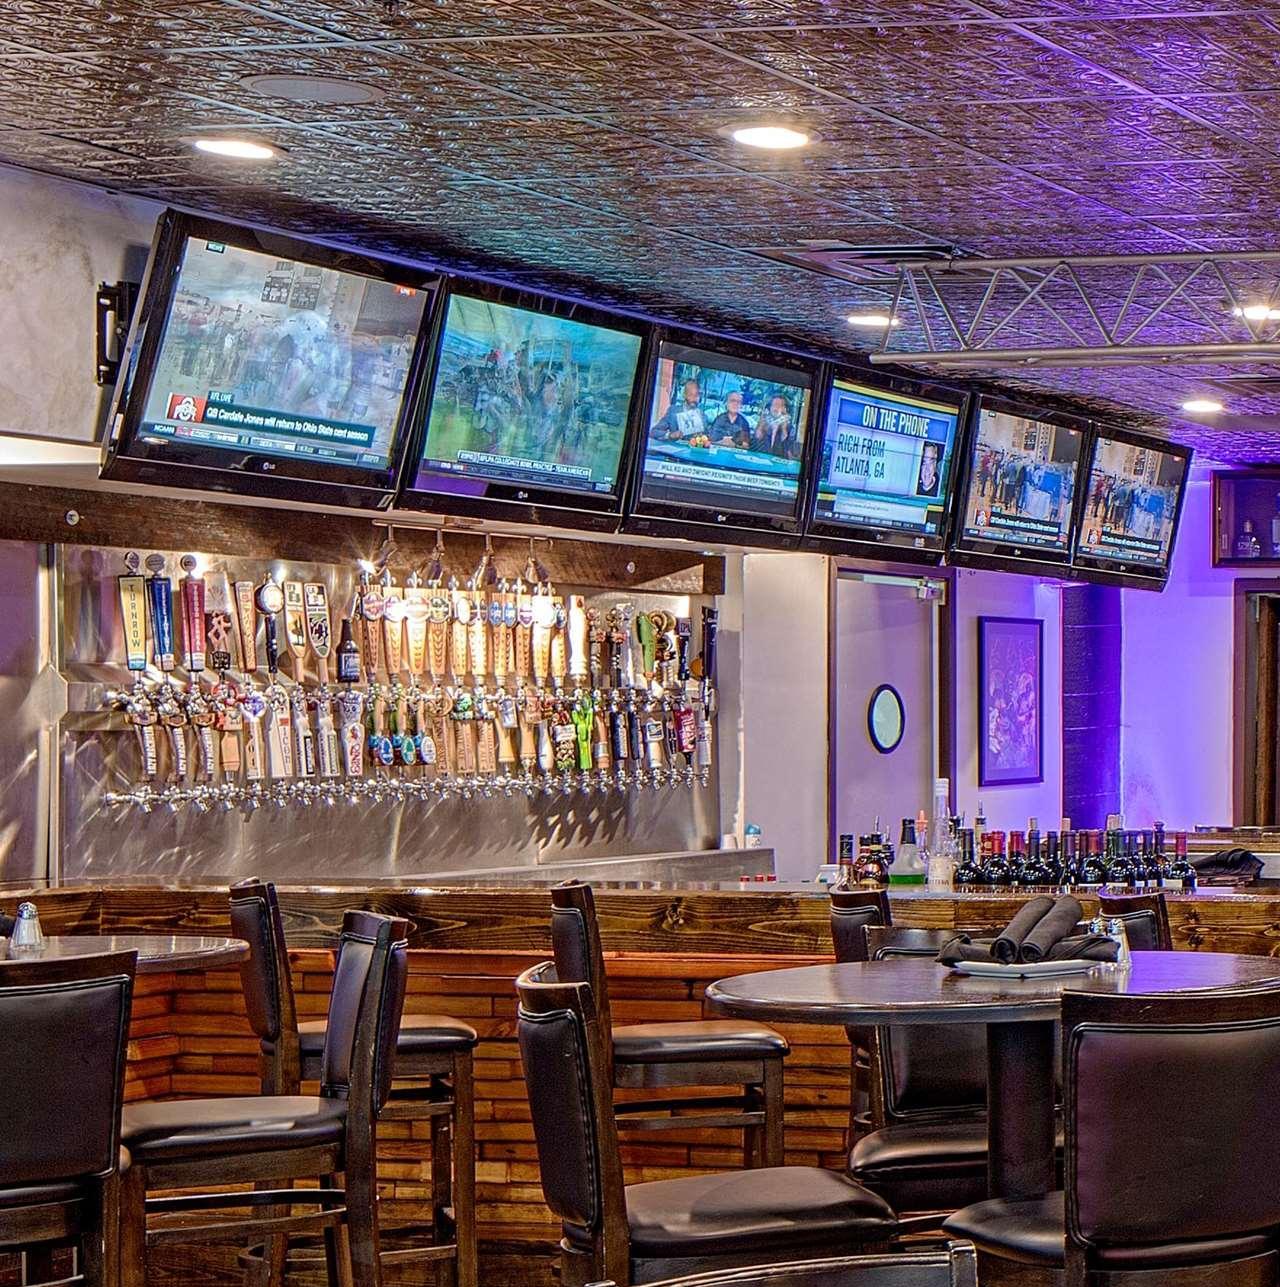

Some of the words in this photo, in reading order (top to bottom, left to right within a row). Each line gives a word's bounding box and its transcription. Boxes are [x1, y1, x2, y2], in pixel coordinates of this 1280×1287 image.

[244, 413, 264, 426] Jones
[264, 416, 276, 428] will
[276, 418, 295, 430] return
[295, 421, 303, 431] to
[303, 422, 318, 434] Ohio
[318, 425, 333, 437] State
[862, 405, 878, 428] ON
[879, 408, 897, 432] THE
[898, 413, 930, 438] PHONE
[838, 433, 858, 454] RICH
[862, 436, 886, 458] FROM
[834, 455, 872, 480] ATLANTA,
[874, 462, 885, 479] GA
